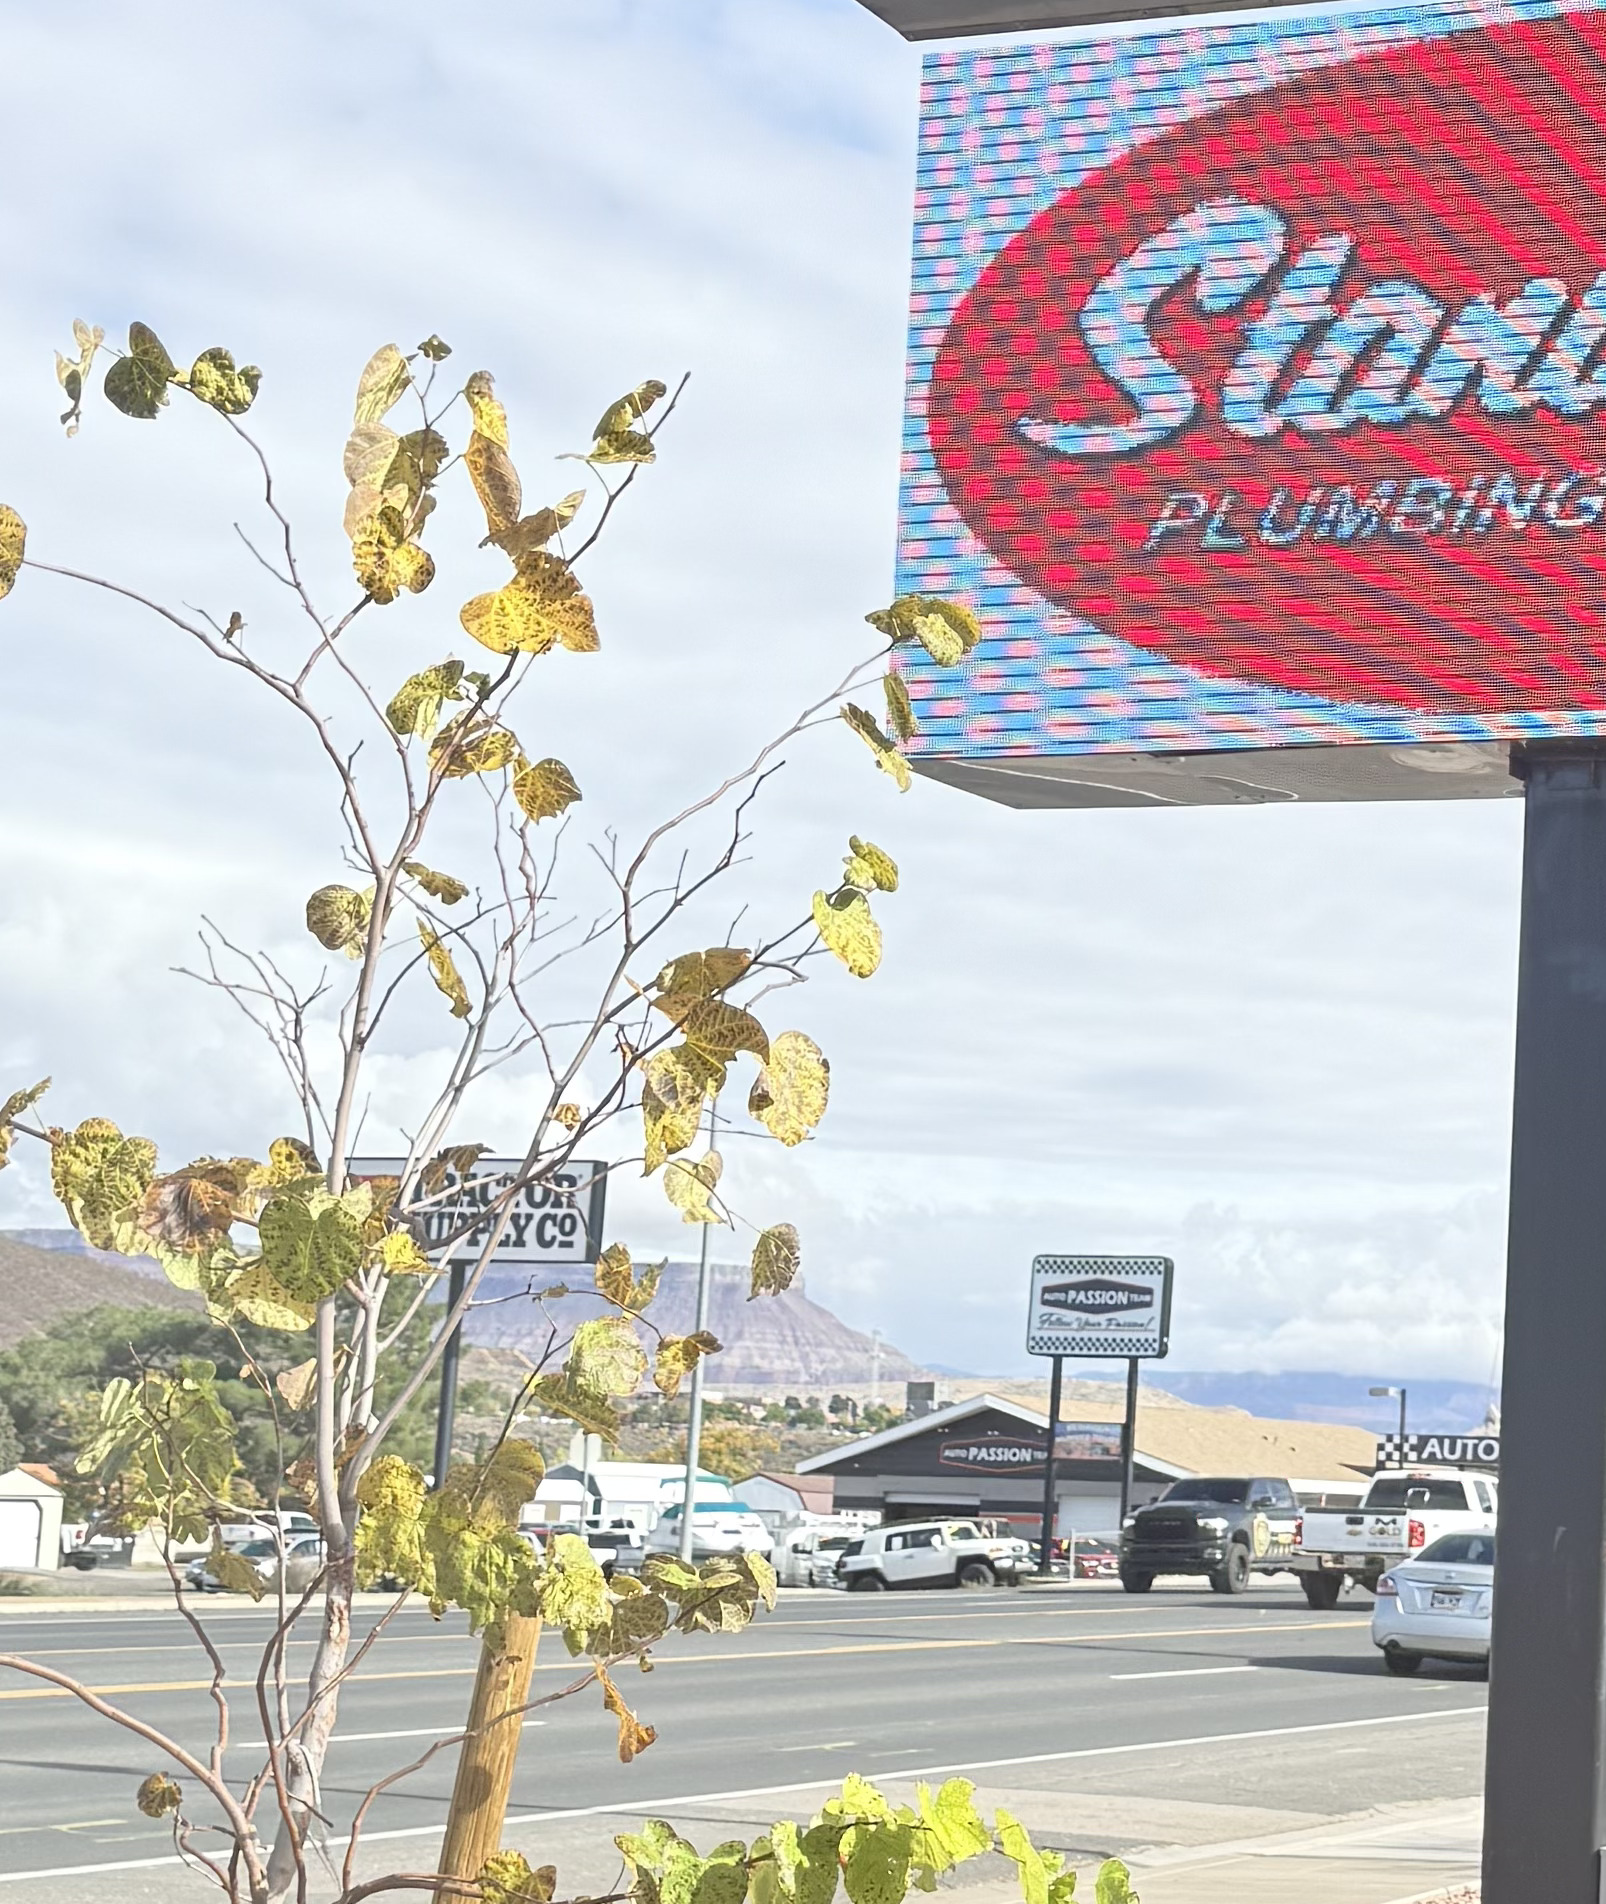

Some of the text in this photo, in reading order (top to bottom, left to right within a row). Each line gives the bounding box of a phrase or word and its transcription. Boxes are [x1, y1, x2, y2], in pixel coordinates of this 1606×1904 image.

[408, 1212, 533, 1248] UPPLY
[1067, 1290, 1128, 1305] PASSION
[968, 1446, 1032, 1462] PASSION
[1421, 1437, 1500, 1461] AUTO
